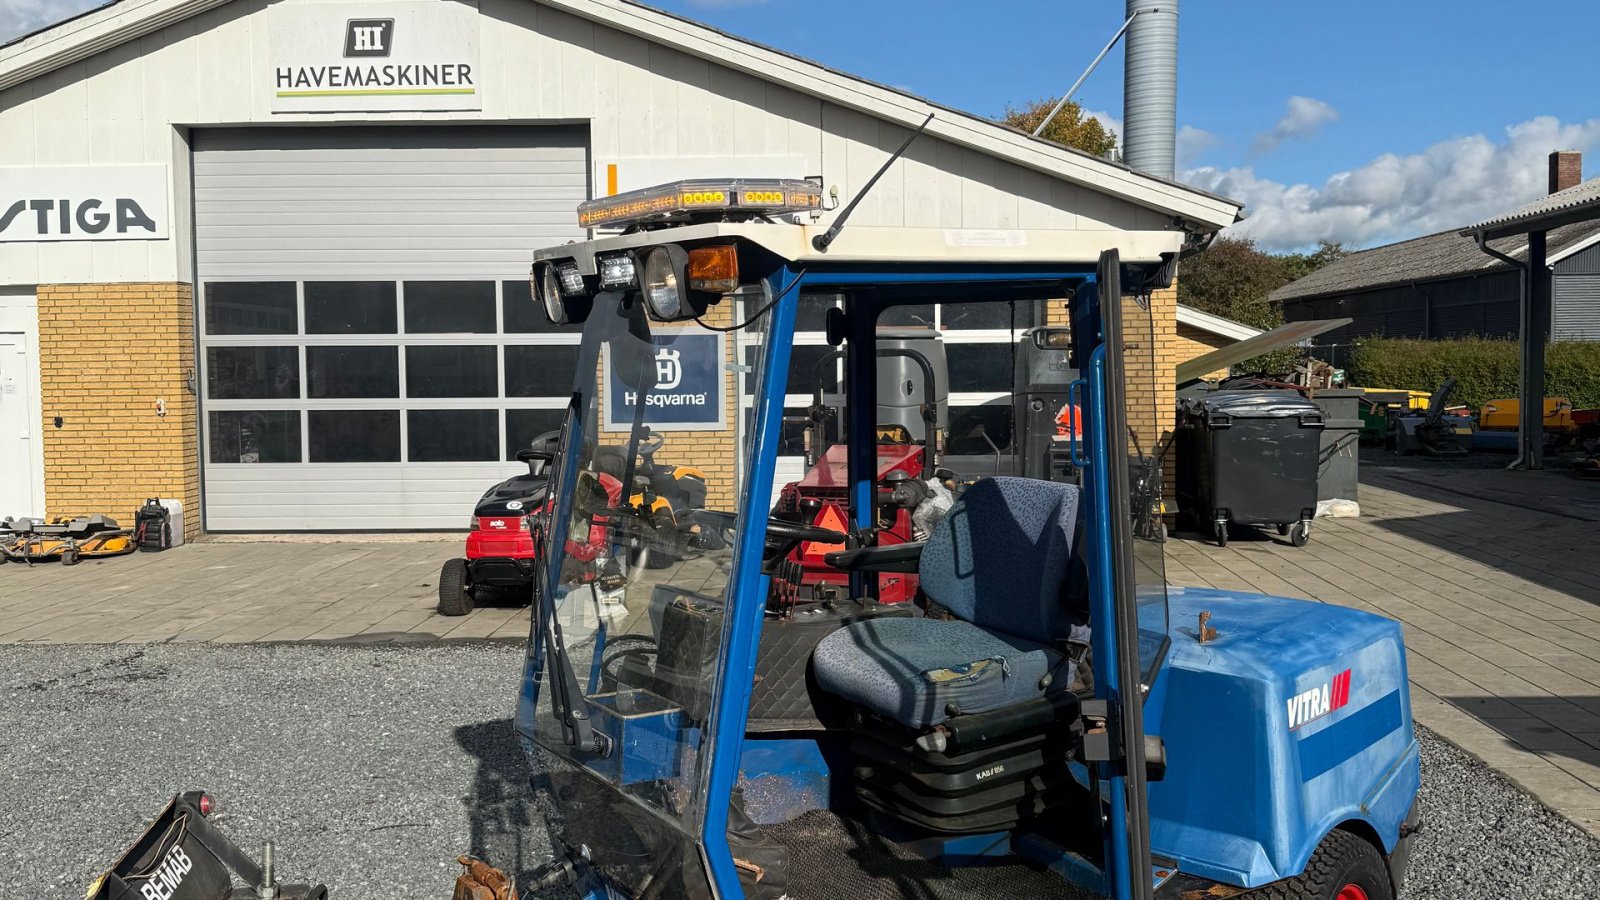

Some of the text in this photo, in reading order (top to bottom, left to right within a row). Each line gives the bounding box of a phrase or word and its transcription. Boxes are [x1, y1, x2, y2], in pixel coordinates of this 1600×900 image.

[353, 26, 384, 51] HI
[276, 63, 474, 88] HAVEMASKINER
[624, 391, 707, 408] Hsqvarna
[1286, 682, 1331, 729] VITRA
